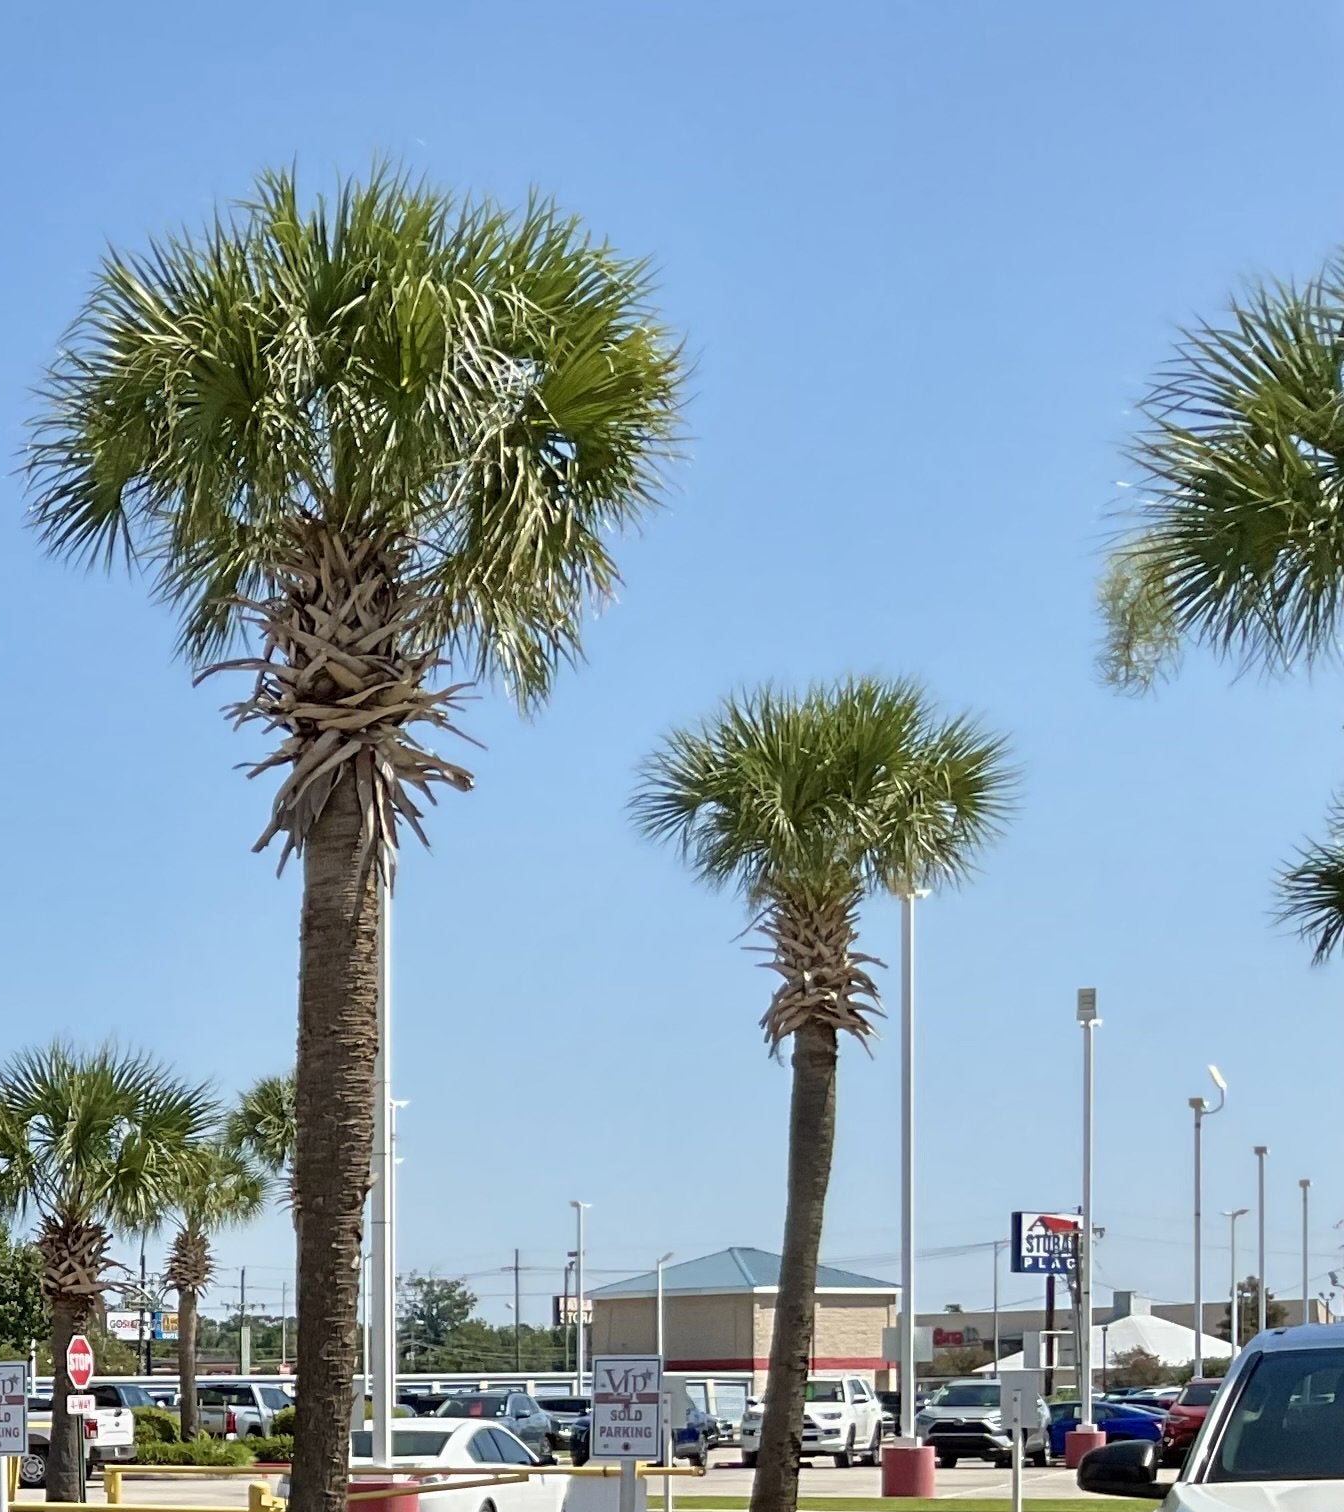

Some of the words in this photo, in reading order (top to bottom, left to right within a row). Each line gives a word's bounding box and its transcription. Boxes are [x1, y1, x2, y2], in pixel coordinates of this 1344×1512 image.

[1023, 1257, 1076, 1270] PLAC
[559, 1311, 593, 1324] STORA
[69, 1353, 92, 1371] STOP
[70, 1399, 91, 1410] 4-WAY
[610, 1409, 643, 1421] SOLD
[599, 1425, 652, 1438] PARKING
